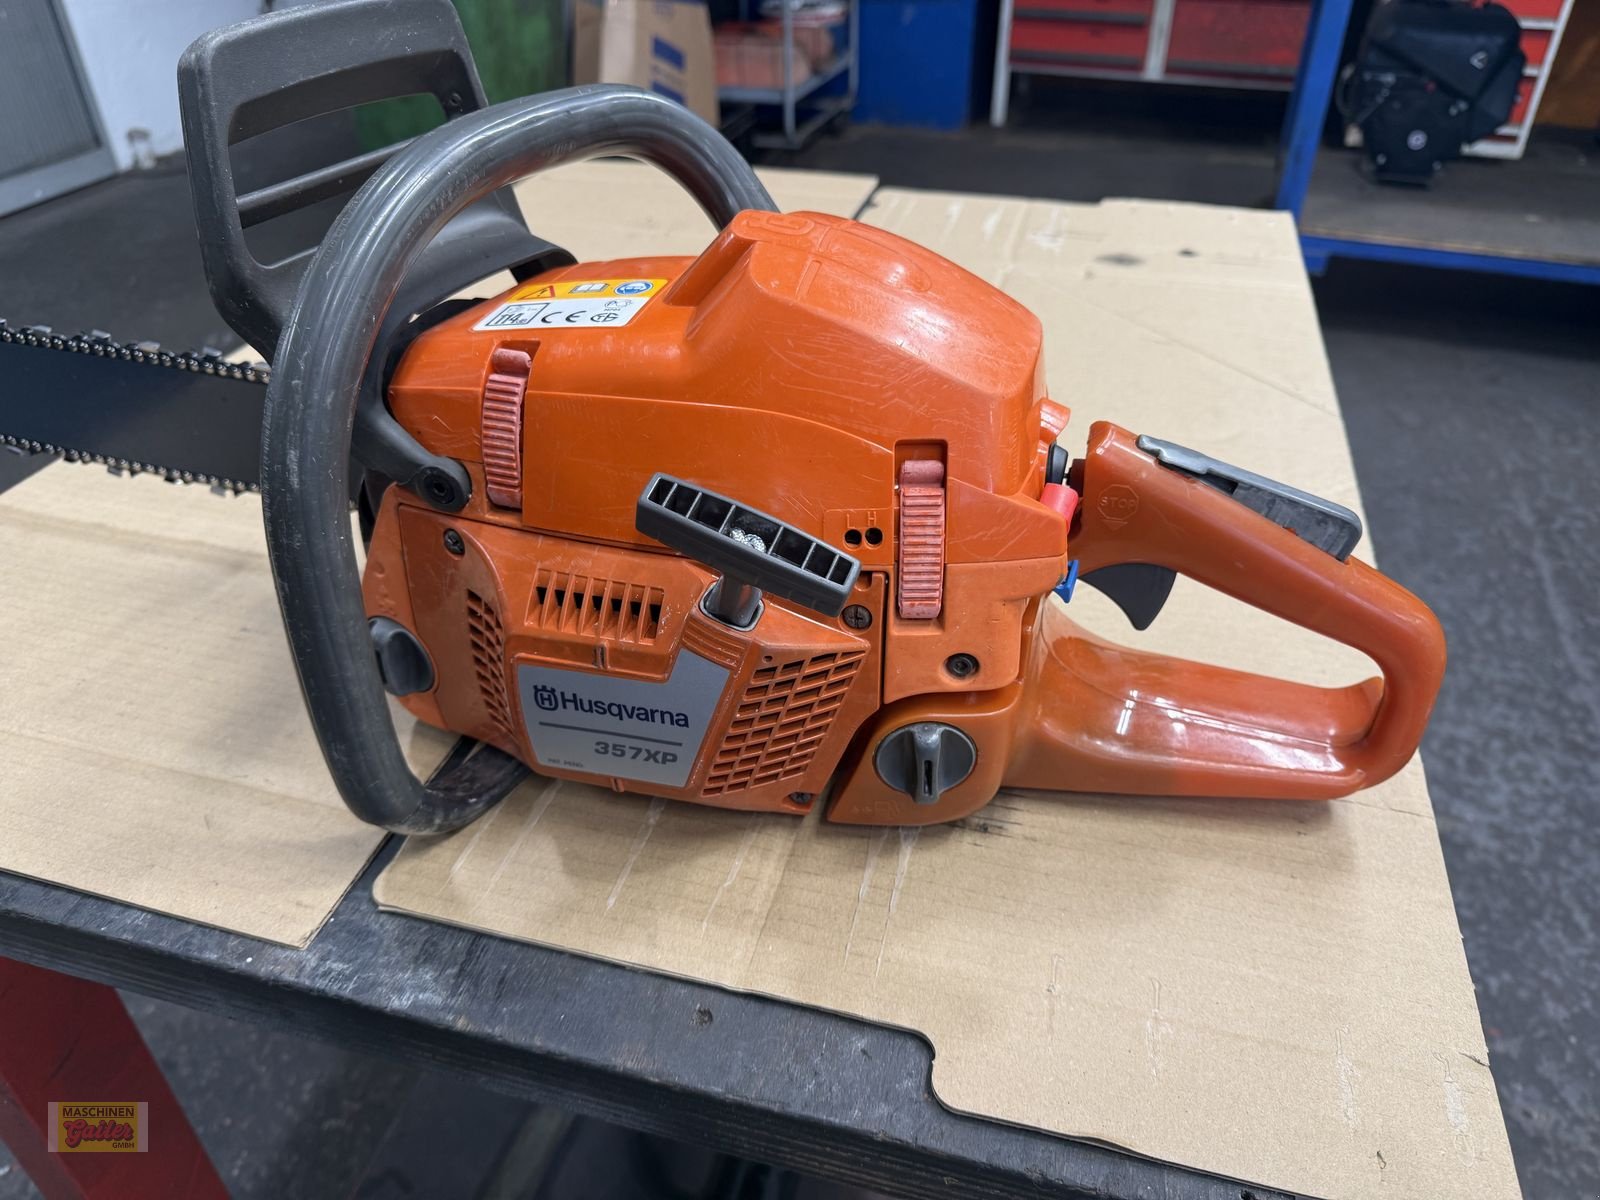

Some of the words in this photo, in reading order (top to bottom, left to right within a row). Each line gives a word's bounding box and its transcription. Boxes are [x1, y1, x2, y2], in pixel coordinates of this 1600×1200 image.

[1100, 496, 1136, 510] STOP
[846, 513, 856, 529] L
[867, 511, 877, 527] H
[561, 690, 690, 729] Husqvarna
[594, 741, 679, 766] 357XP
